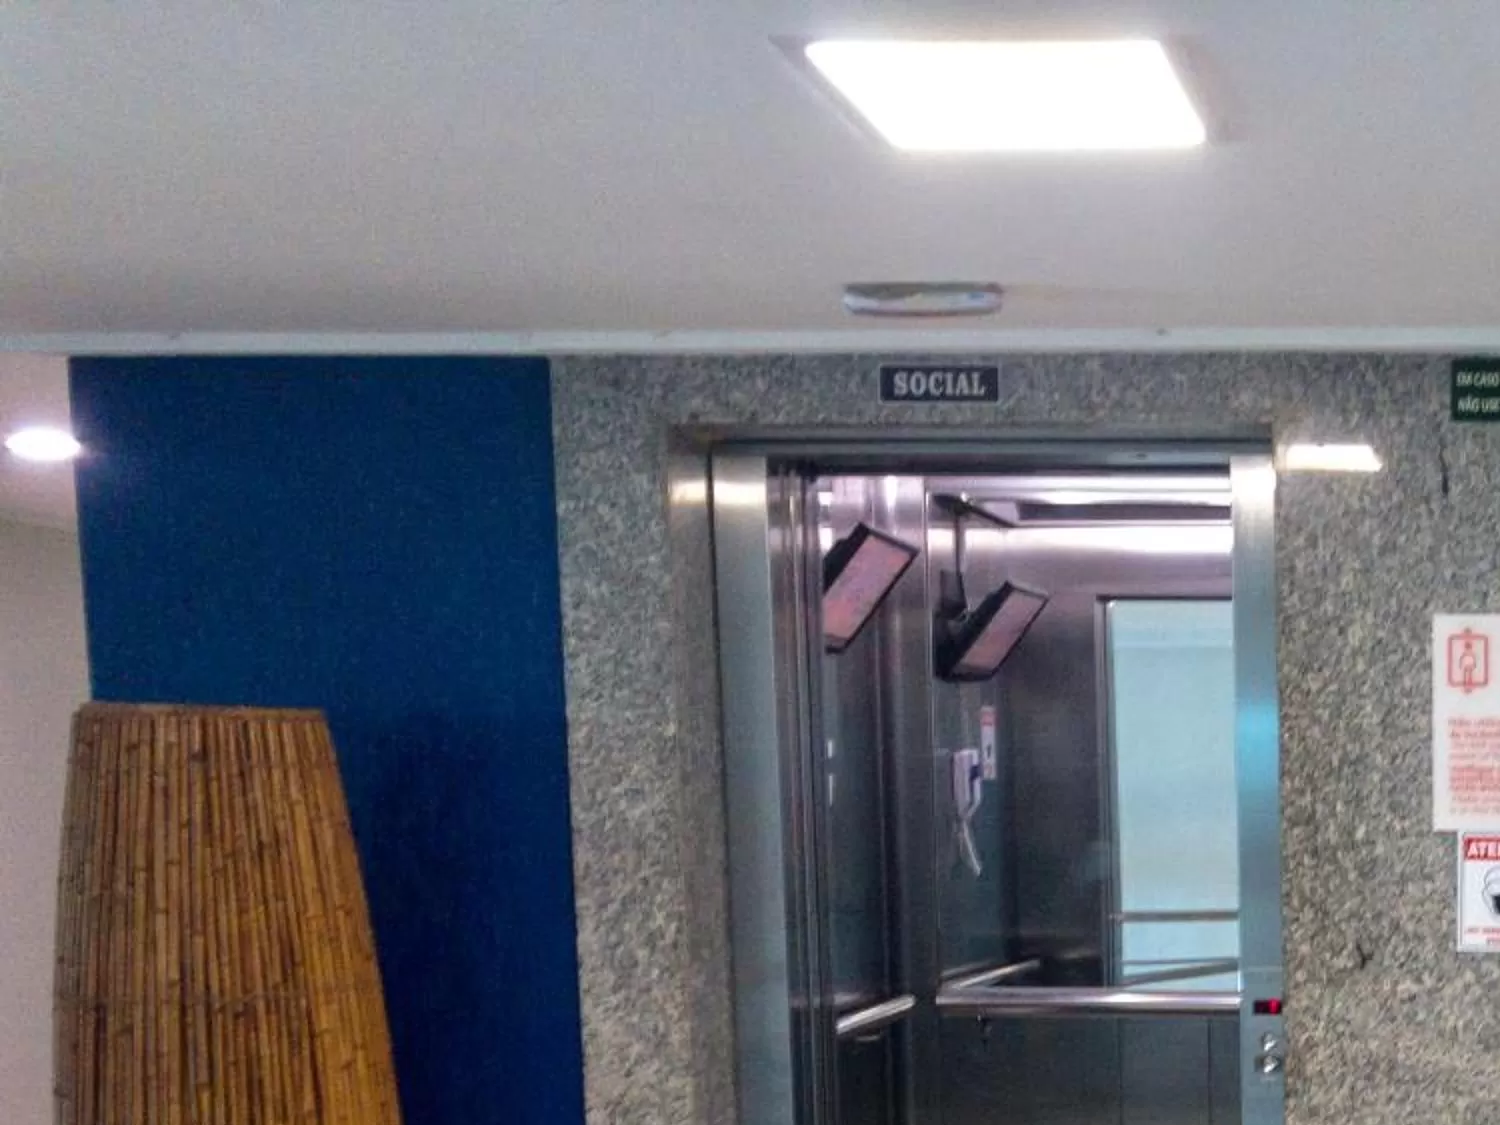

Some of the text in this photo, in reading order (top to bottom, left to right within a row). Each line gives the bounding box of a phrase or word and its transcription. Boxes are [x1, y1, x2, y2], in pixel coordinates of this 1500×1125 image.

[893, 370, 985, 397] SOCIAL
[1474, 371, 1500, 388] CASO
[1458, 394, 1480, 413] NÃO
